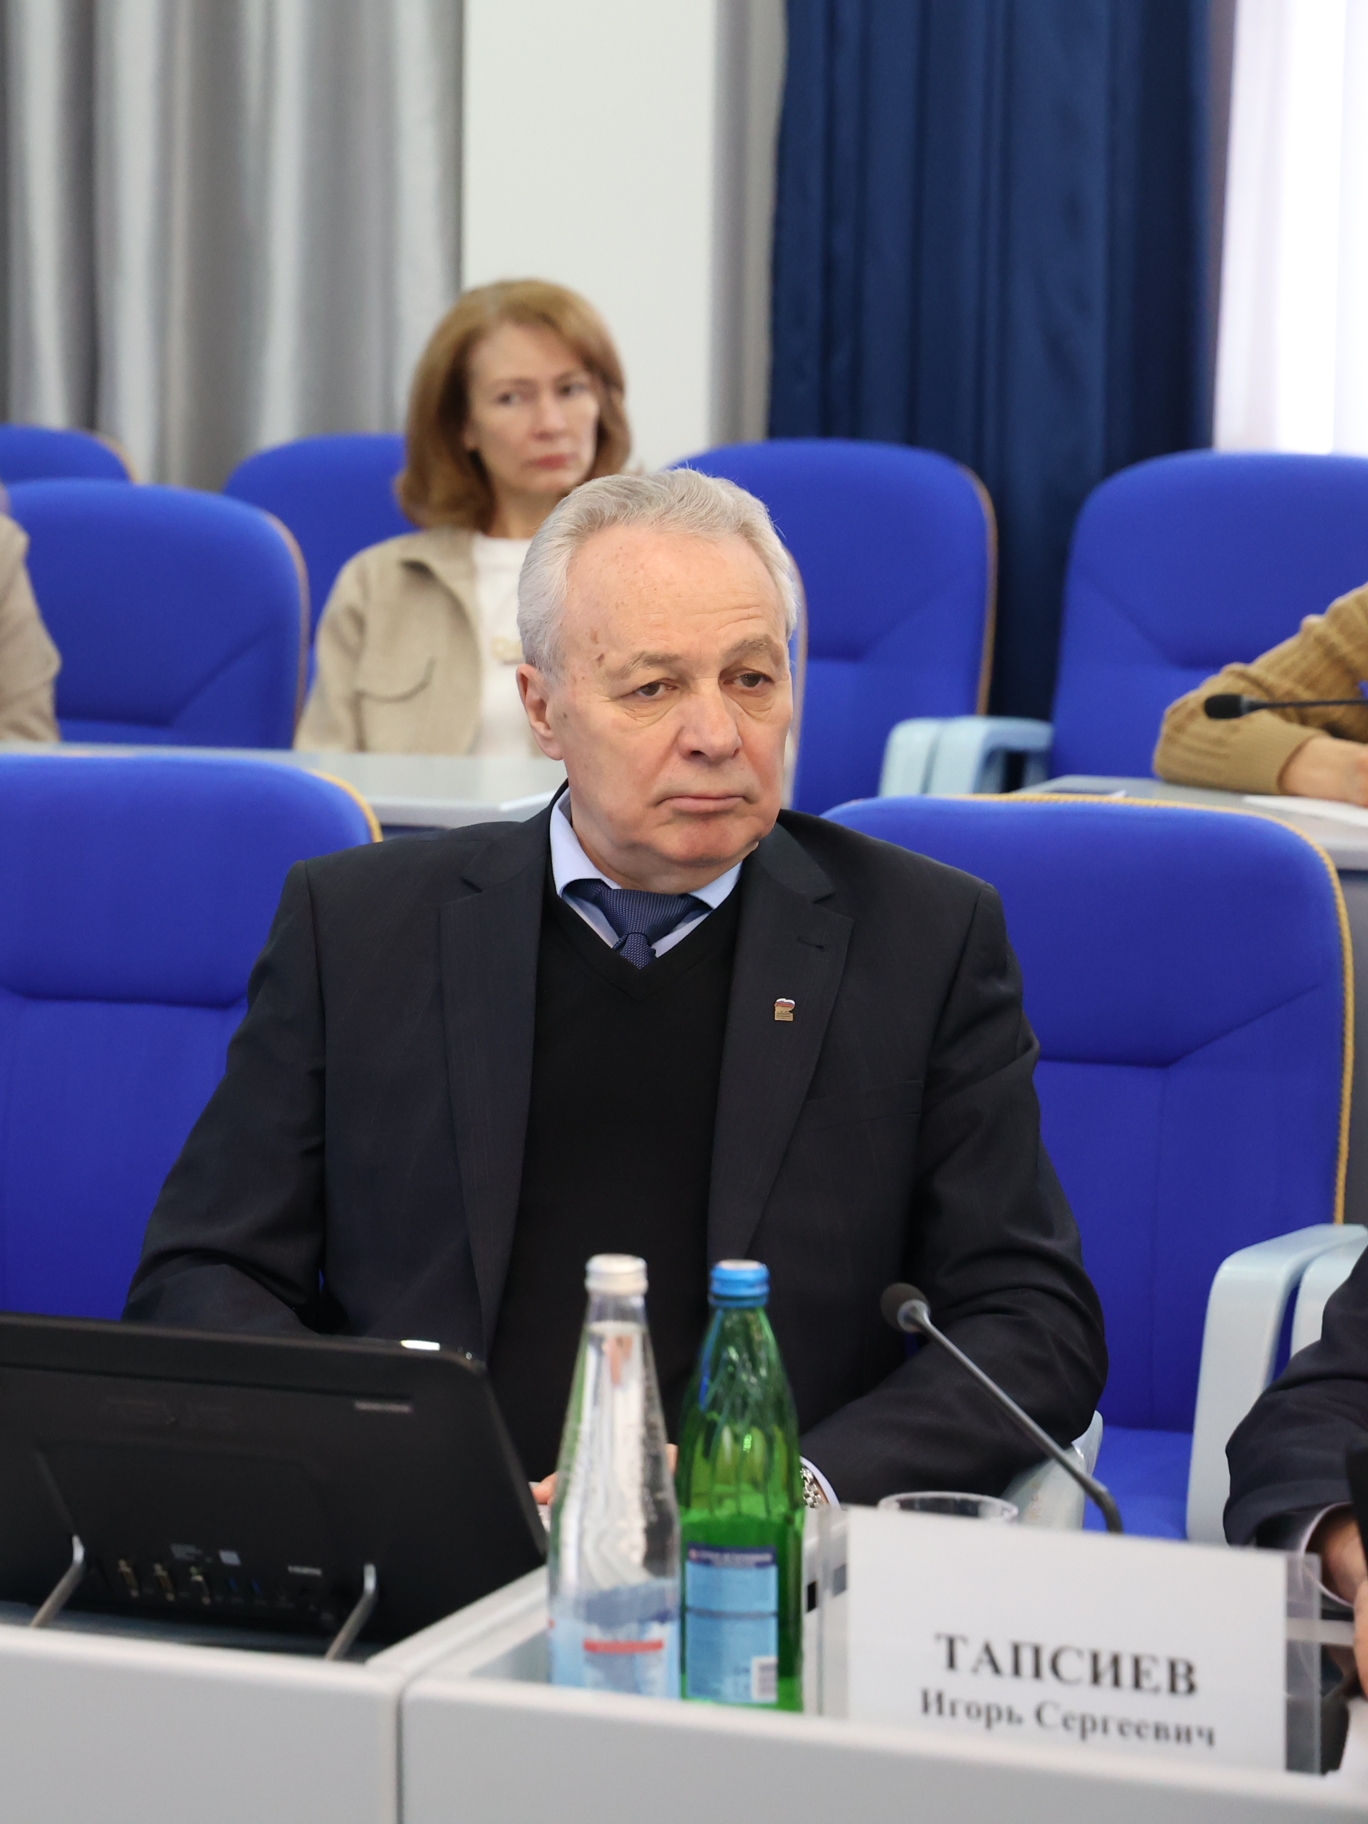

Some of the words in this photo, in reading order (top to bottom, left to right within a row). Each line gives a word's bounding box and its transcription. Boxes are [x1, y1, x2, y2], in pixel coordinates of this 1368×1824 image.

[935, 1632, 1198, 1697] ТАПСИЕВ
[921, 1688, 1023, 1731] Игорь
[1034, 1700, 1215, 1749] Сергеевич
